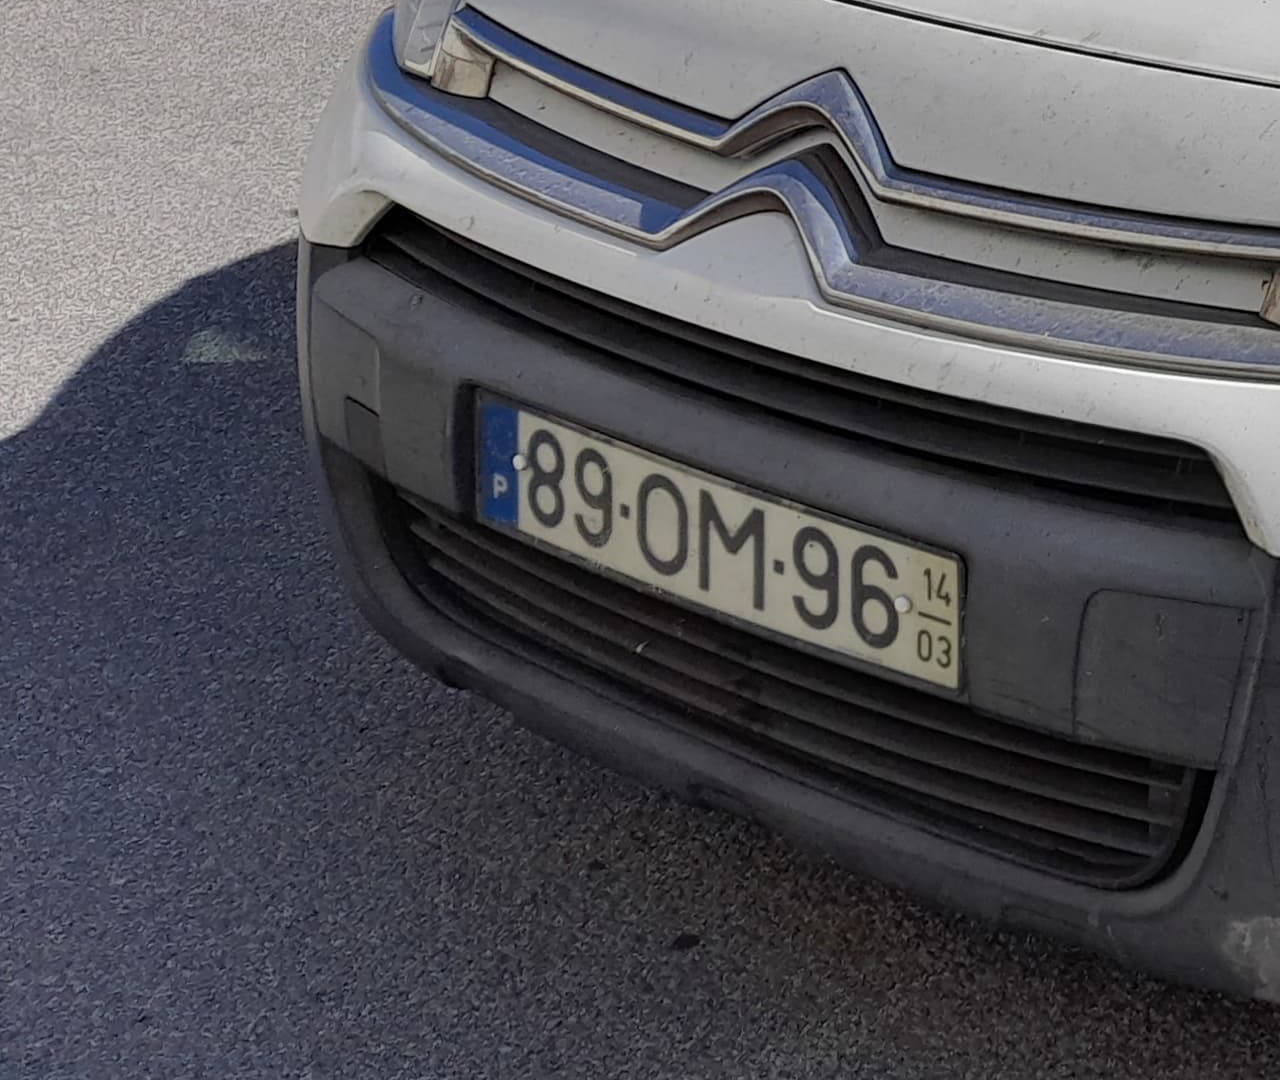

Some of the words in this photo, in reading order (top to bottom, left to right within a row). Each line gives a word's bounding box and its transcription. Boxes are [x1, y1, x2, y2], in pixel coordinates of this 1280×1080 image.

[493, 473, 507, 499] P
[922, 567, 952, 606] 14
[916, 629, 952, 670] 03
